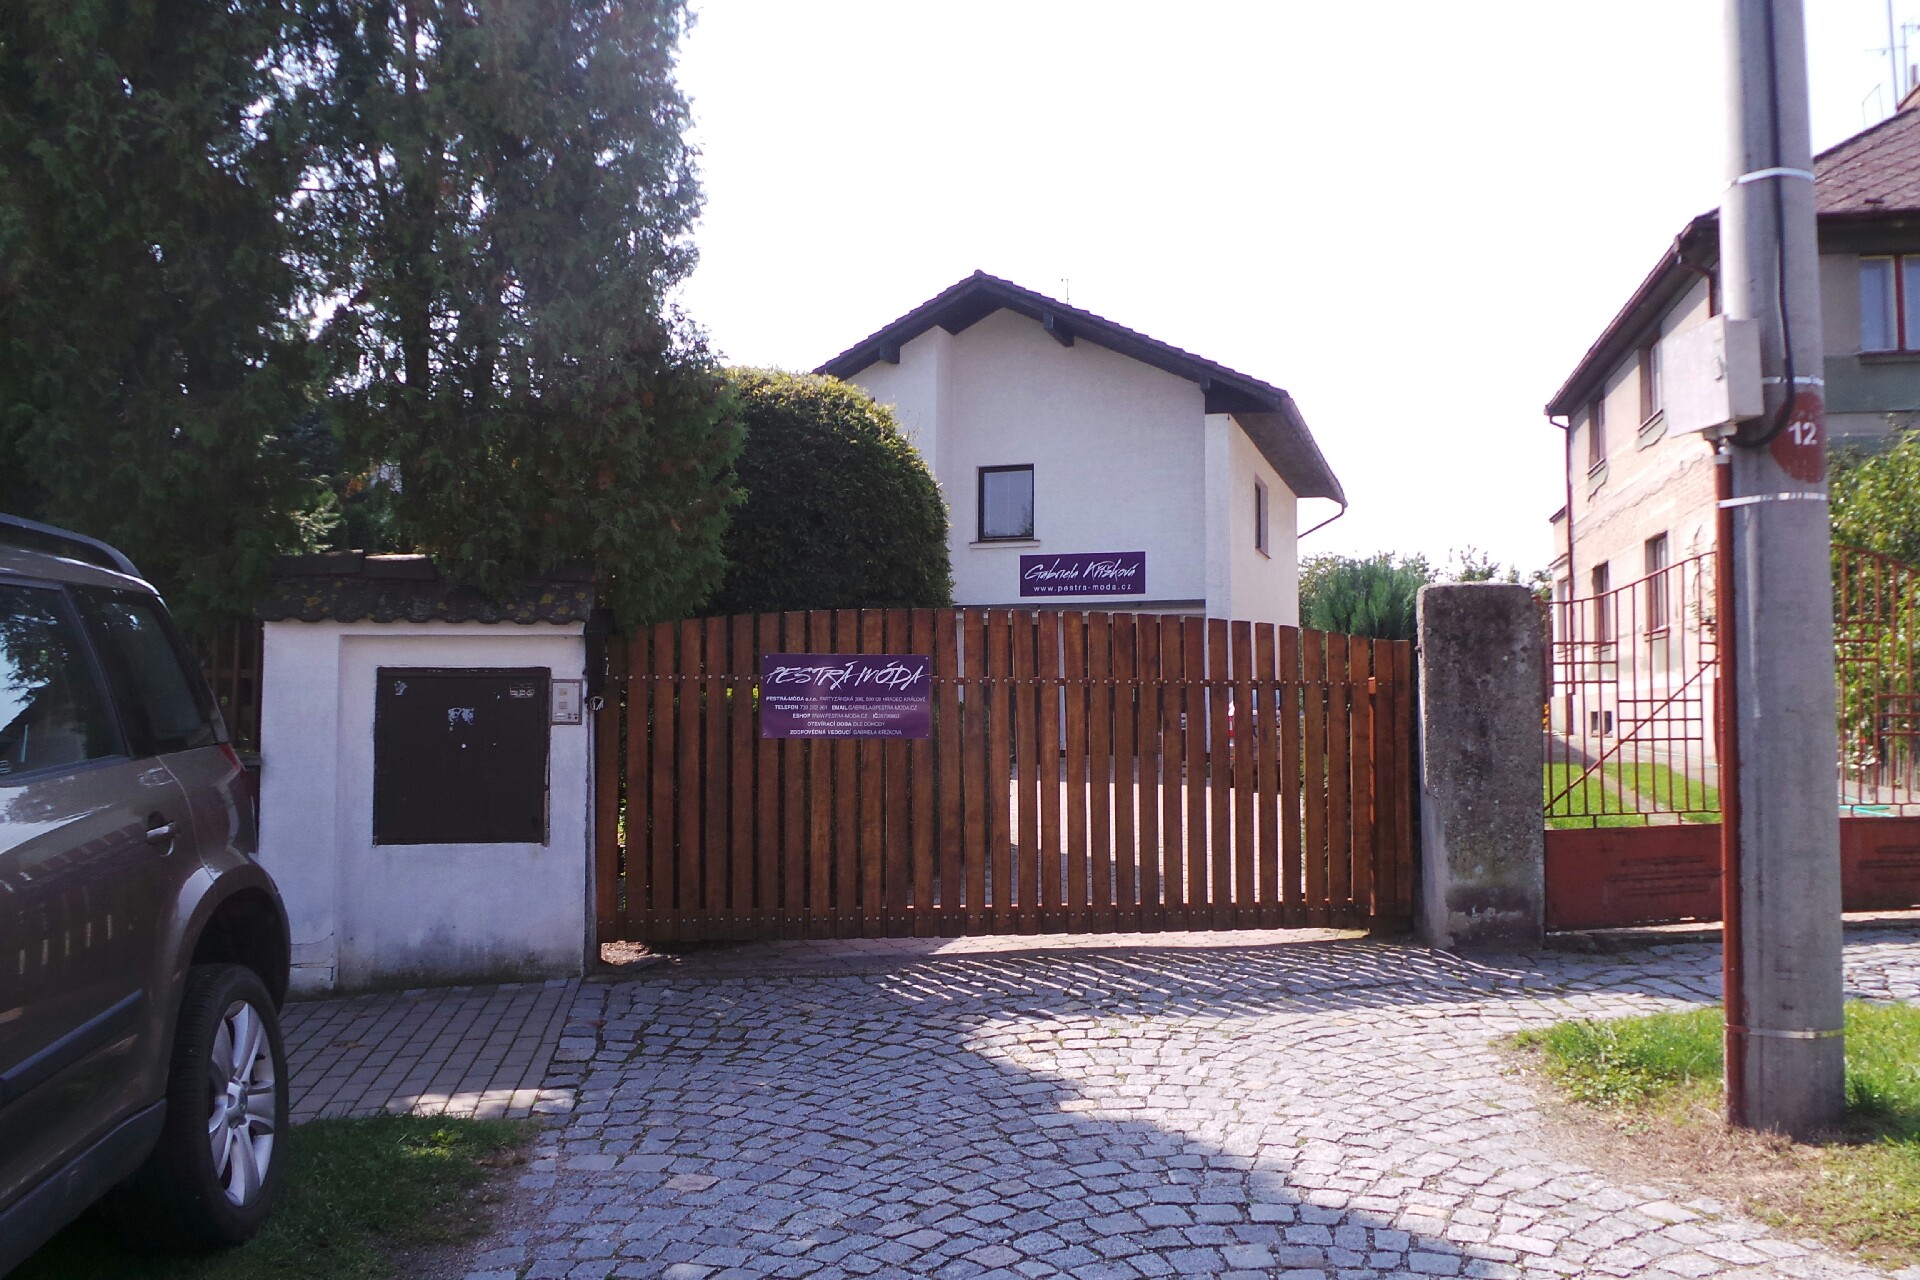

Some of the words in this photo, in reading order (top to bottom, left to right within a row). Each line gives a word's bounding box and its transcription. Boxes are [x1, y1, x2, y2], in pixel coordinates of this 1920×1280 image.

[1787, 421, 1817, 445] 12
[1024, 558, 1079, 582] Gabriela
[1033, 583, 1132, 592] www.pestra-moda.cz
[765, 661, 860, 691] PESTRÁ
[854, 661, 930, 691] MÓDA
